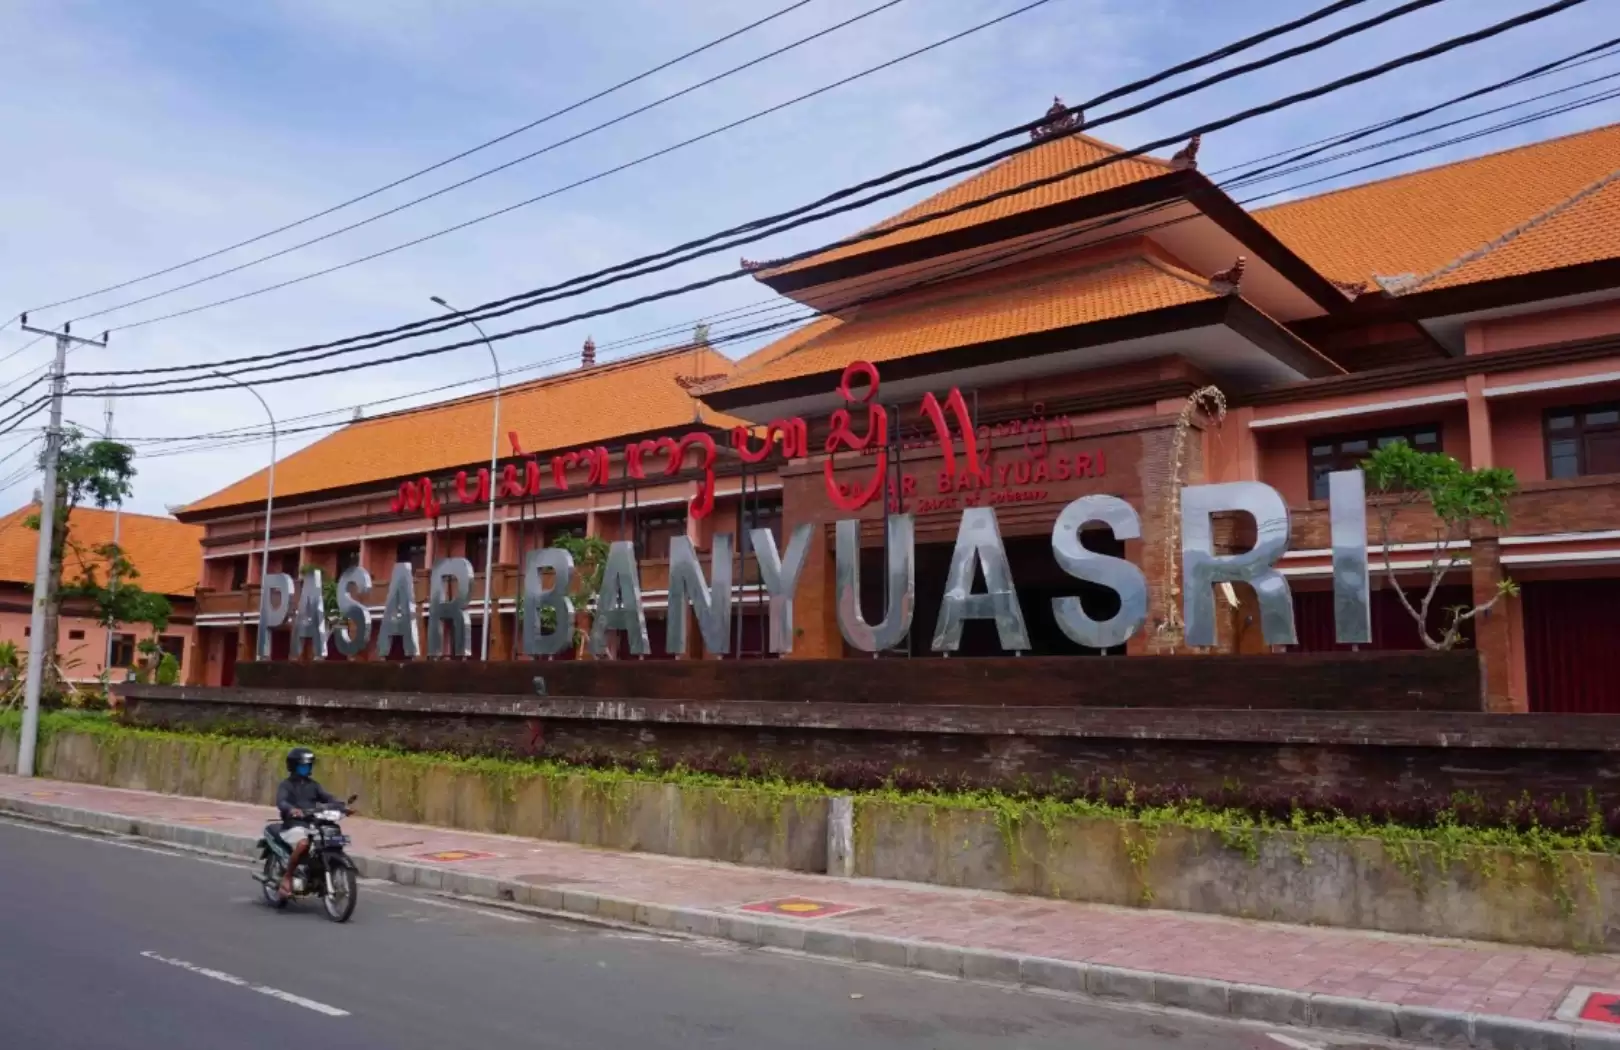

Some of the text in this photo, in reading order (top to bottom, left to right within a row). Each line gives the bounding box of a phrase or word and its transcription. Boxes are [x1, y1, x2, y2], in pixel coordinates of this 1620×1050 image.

[936, 448, 1107, 494] BANYUASRI
[256, 469, 1373, 658] PASAR BANYUASRI
